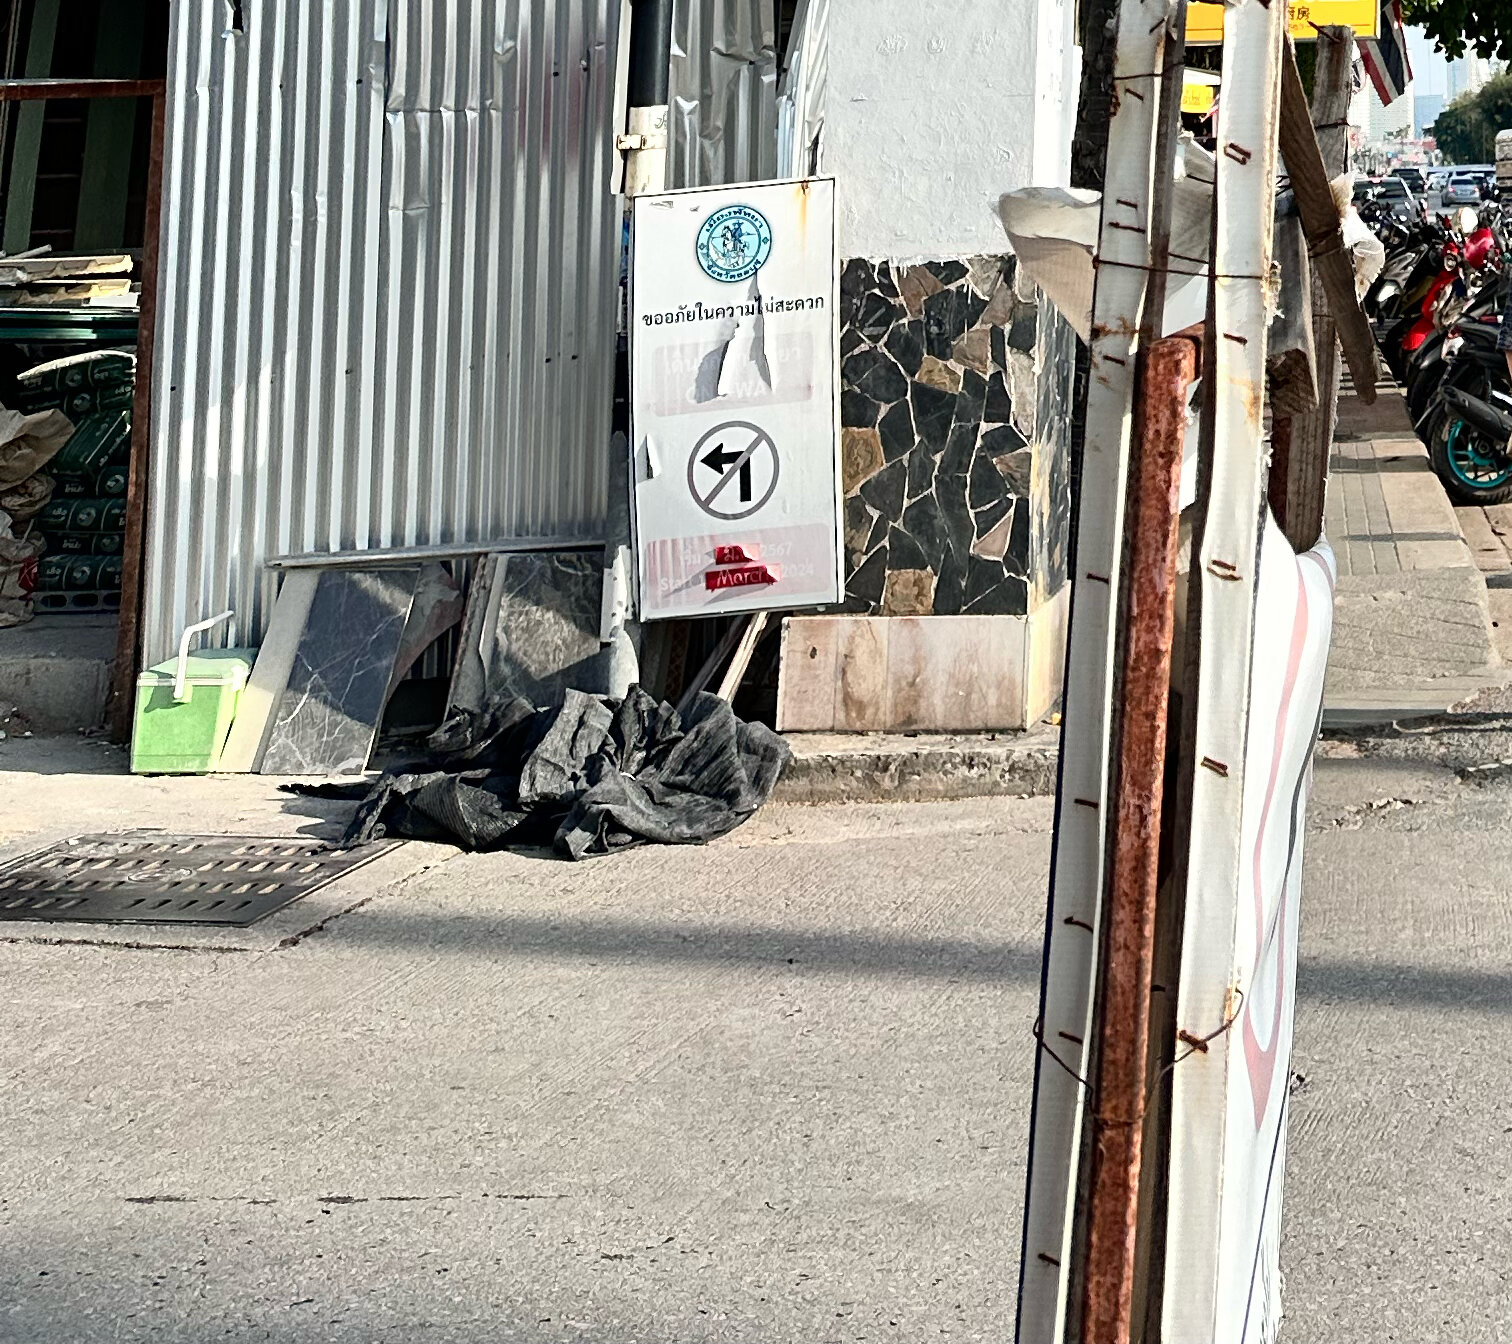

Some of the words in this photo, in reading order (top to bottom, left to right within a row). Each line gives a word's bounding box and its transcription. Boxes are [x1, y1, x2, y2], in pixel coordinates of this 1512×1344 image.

[642, 295, 825, 326] ขออภัยในความไม่สะดวก
